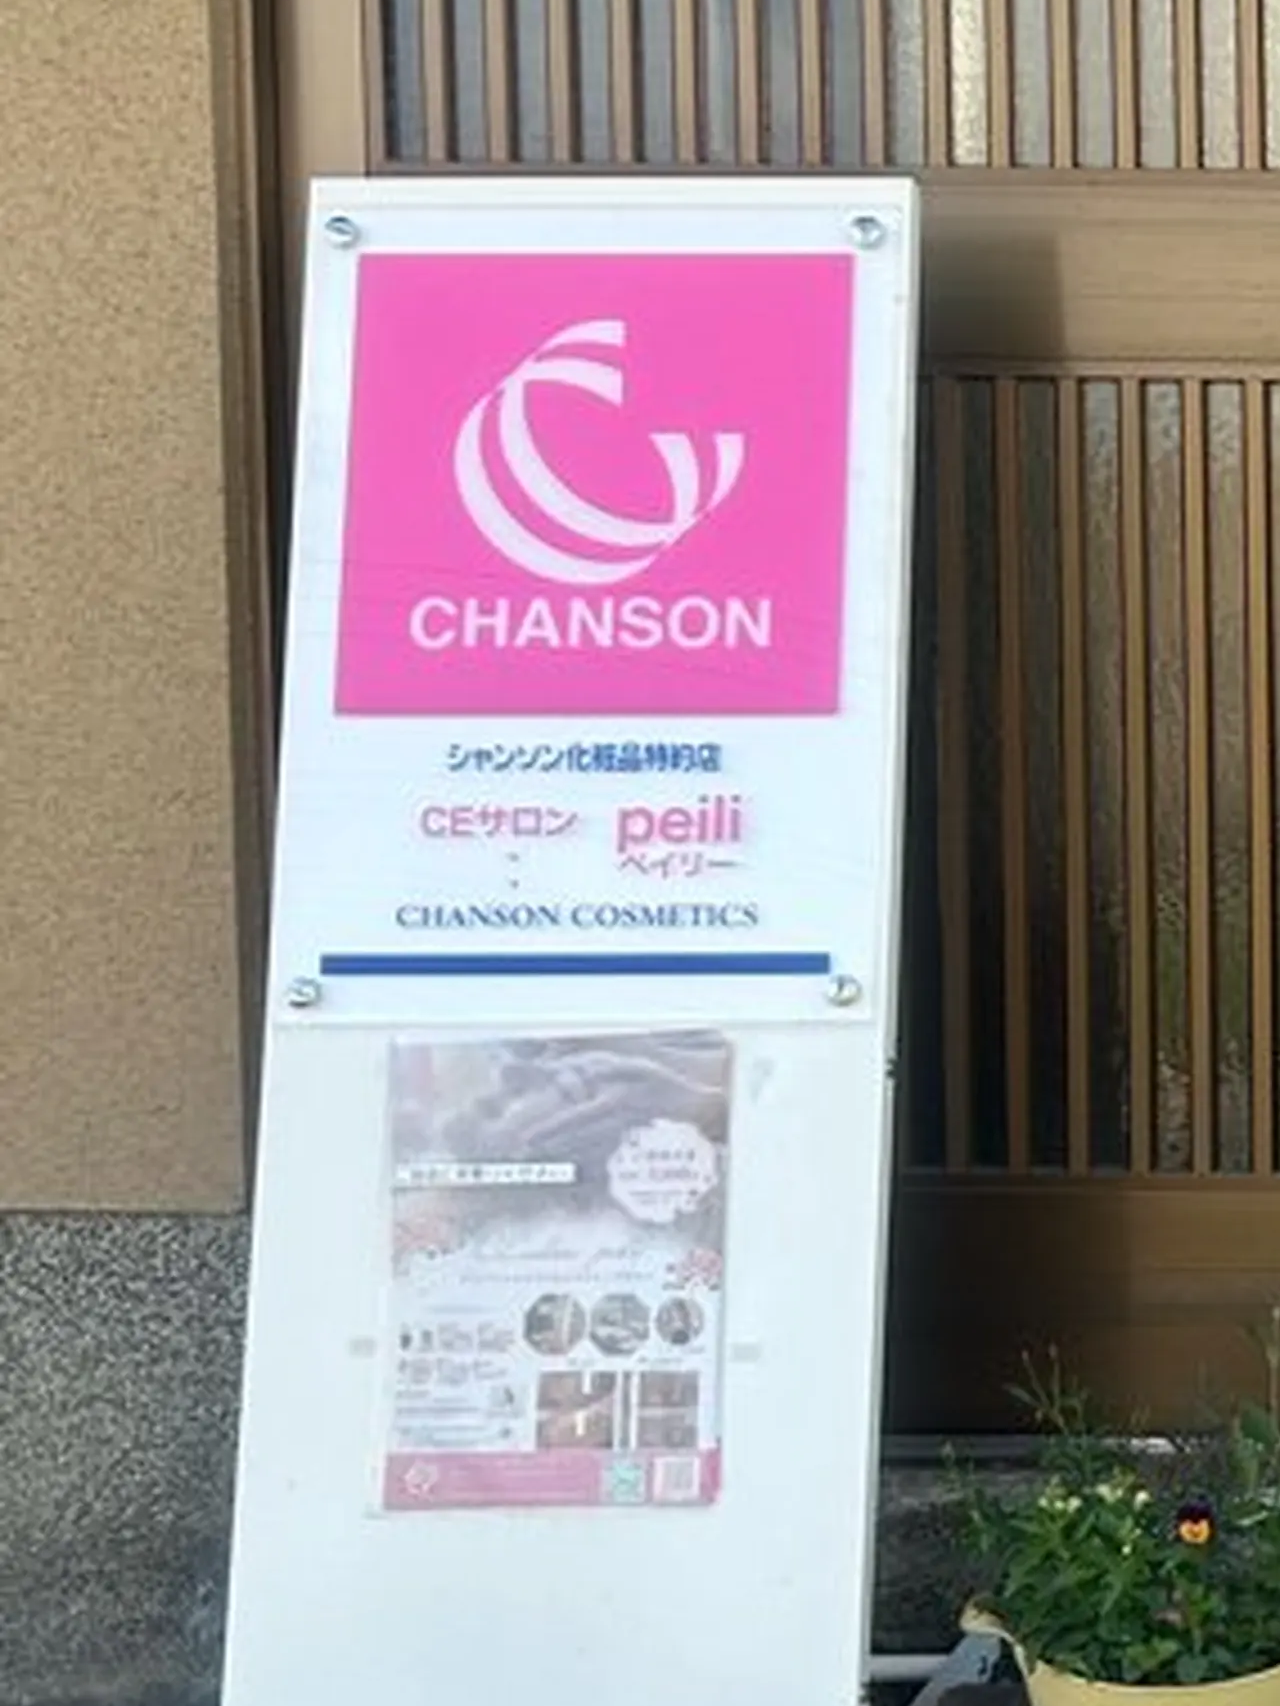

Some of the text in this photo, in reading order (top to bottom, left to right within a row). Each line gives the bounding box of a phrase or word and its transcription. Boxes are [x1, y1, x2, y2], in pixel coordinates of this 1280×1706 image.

[409, 597, 771, 649] CHANSON
[446, 743, 721, 772] シャンソン化粧品特約店
[420, 794, 742, 852] CEサロン peili
[395, 903, 758, 929] CHANSON COSMETICS
